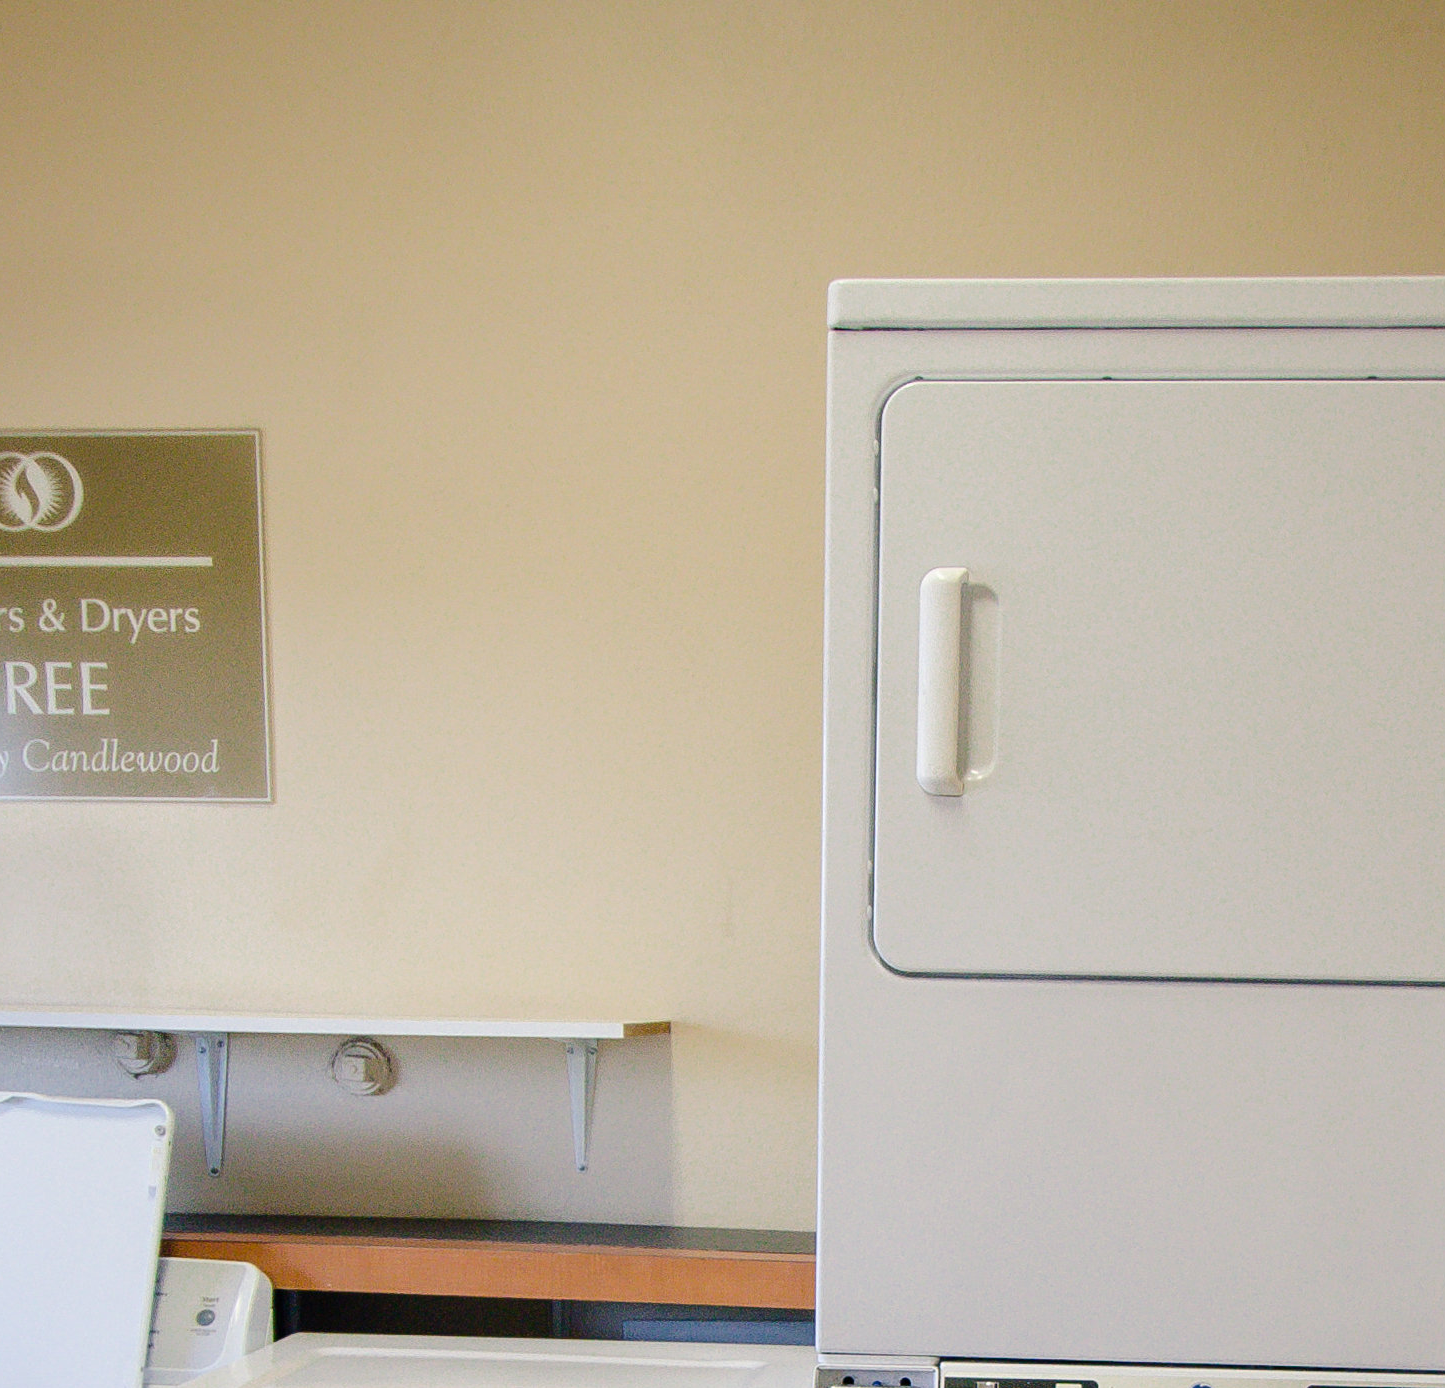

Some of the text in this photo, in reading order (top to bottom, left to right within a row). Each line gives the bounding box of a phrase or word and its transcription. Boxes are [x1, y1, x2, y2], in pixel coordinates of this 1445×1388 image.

[39, 599, 65, 632] &
[81, 599, 200, 643] Dryers
[22, 739, 219, 773] Candlewood
